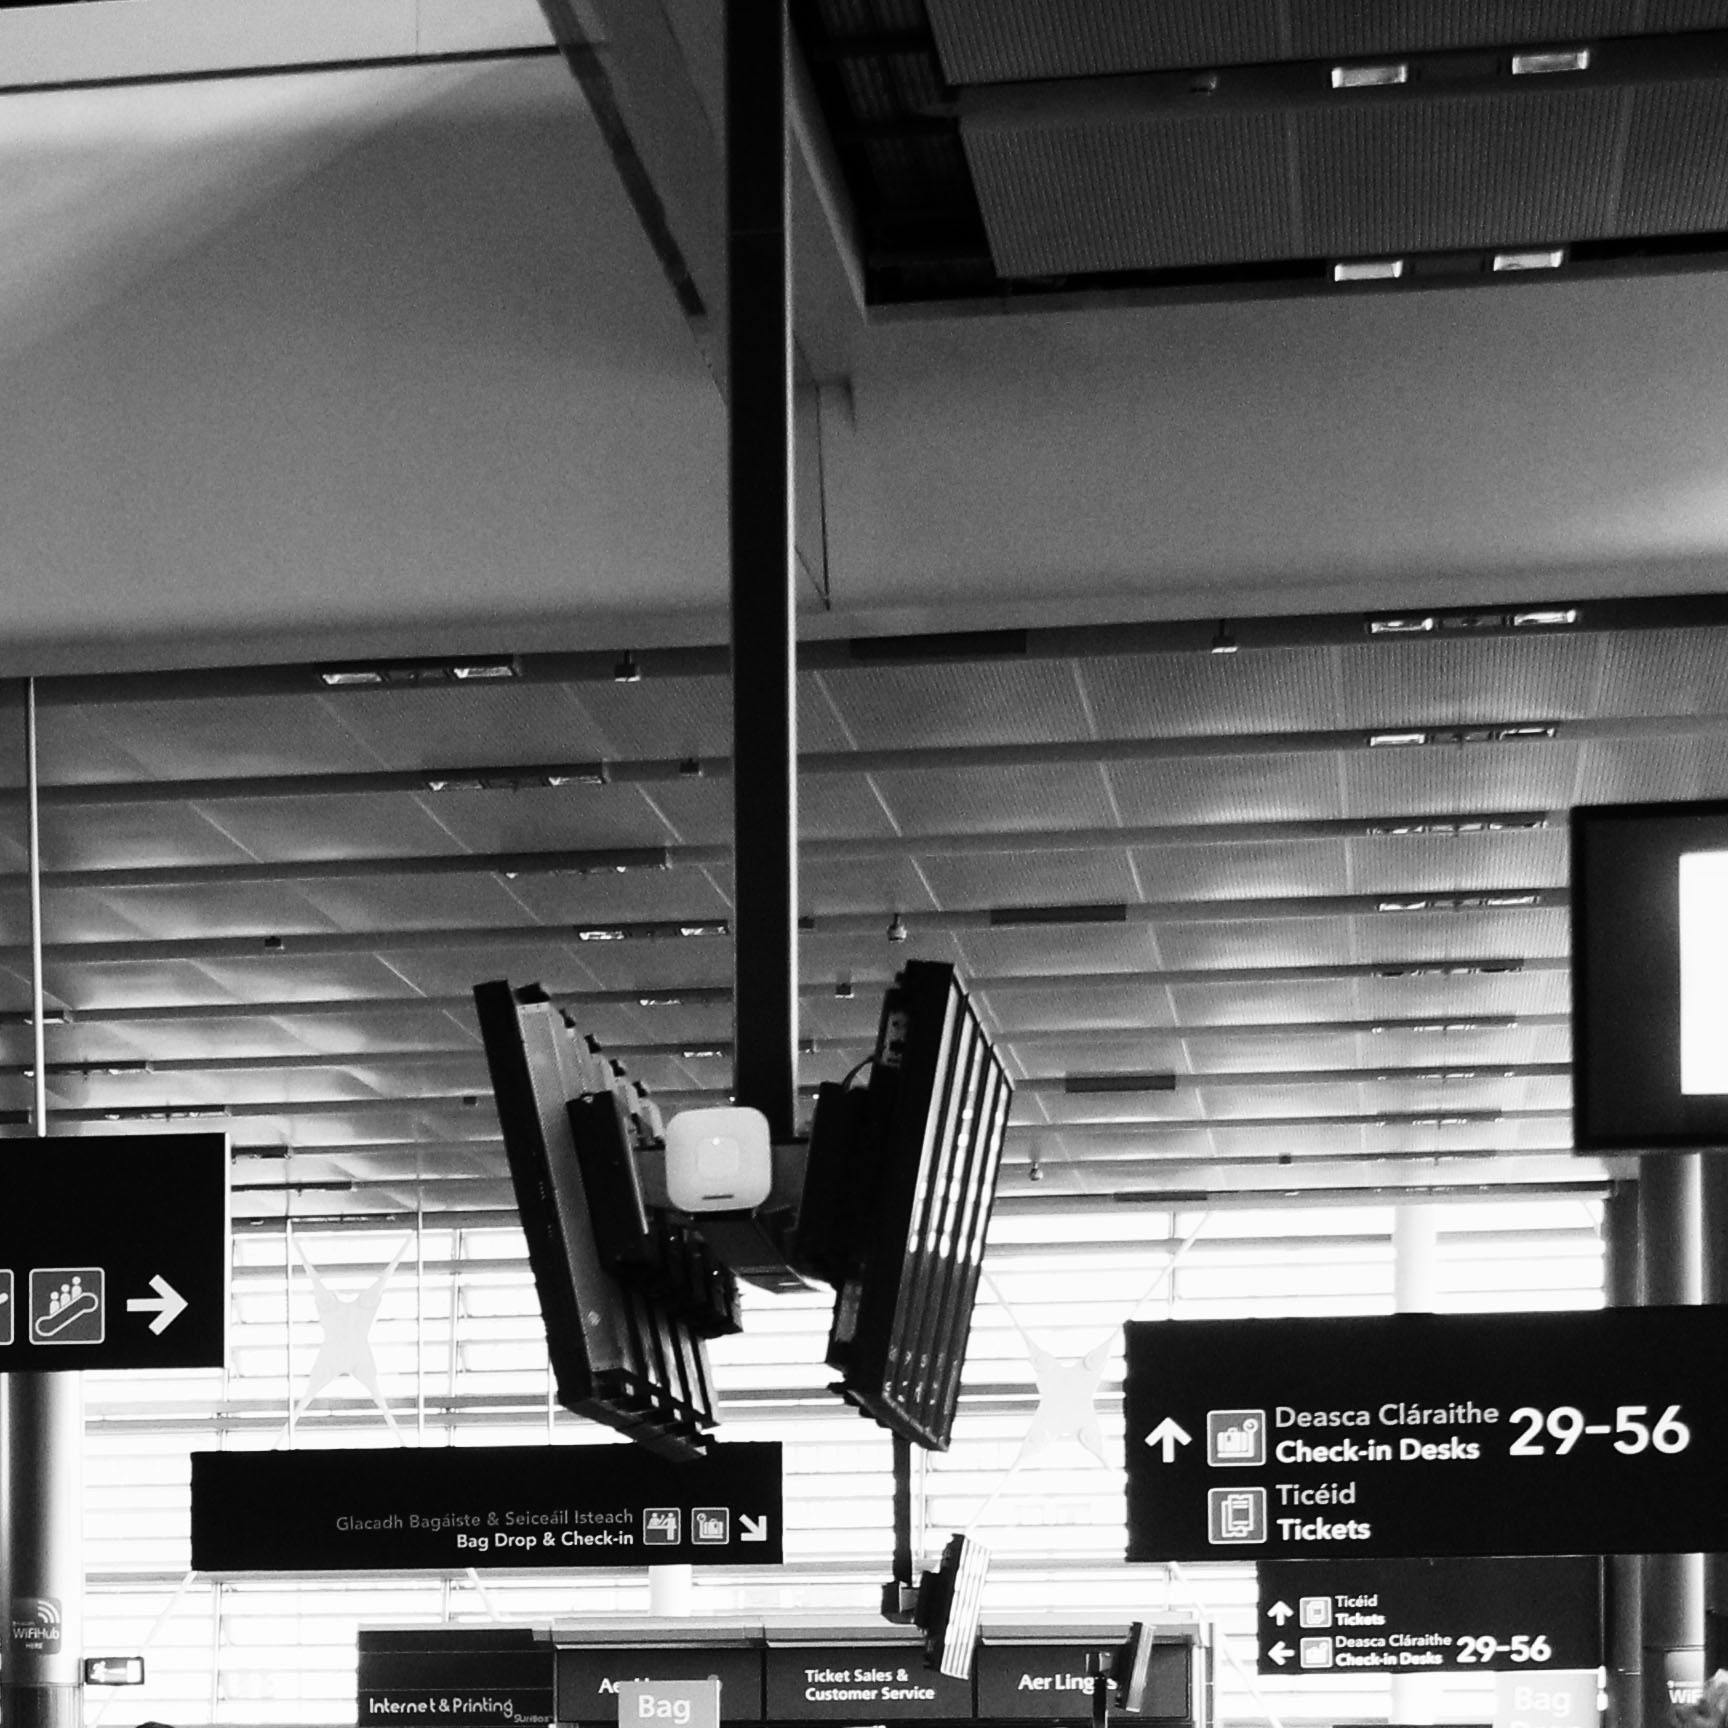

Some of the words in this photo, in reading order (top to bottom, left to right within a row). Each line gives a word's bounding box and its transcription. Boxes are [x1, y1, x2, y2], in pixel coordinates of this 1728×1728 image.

[1275, 1406, 1371, 1429] Deasca
[1378, 1401, 1500, 1426] Cláraithe
[1508, 1404, 1691, 1457] 29-56
[1275, 1438, 1393, 1464] Check-in
[1399, 1436, 1481, 1461] Desks
[1276, 1481, 1357, 1506] Ticéid
[336, 1513, 403, 1532] Glacadh
[409, 1511, 481, 1532] Bagáiste
[486, 1511, 500, 1527] &
[505, 1509, 569, 1526] Seiceáil
[573, 1508, 634, 1526] Isteach
[1277, 1517, 1372, 1541] Tickets
[456, 1533, 489, 1552] Bag
[495, 1531, 537, 1551] Drop
[542, 1532, 556, 1548] &
[561, 1530, 634, 1548] Check-in
[1335, 1594, 1378, 1608] Ticéid
[1335, 1612, 1387, 1627] Tickets
[1335, 1635, 1384, 1649] Deasca
[1386, 1632, 1453, 1647] Cláraithe
[1456, 1635, 1552, 1663] 29-56
[1335, 1652, 1394, 1667] Check-in
[1397, 1651, 1444, 1666] Desks
[804, 1669, 850, 1683] Ticket
[853, 1668, 893, 1683] Sales
[896, 1668, 909, 1683] &
[1018, 1673, 1052, 1691] Aer
[1055, 1671, 1119, 1695] Lings
[805, 1687, 878, 1701] Customer
[881, 1686, 936, 1701] Service
[1514, 1686, 1572, 1717] Bag
[369, 1698, 436, 1714] Internet
[439, 1698, 451, 1713] &
[453, 1696, 514, 1719] Printing
[638, 1694, 691, 1725] Bag
